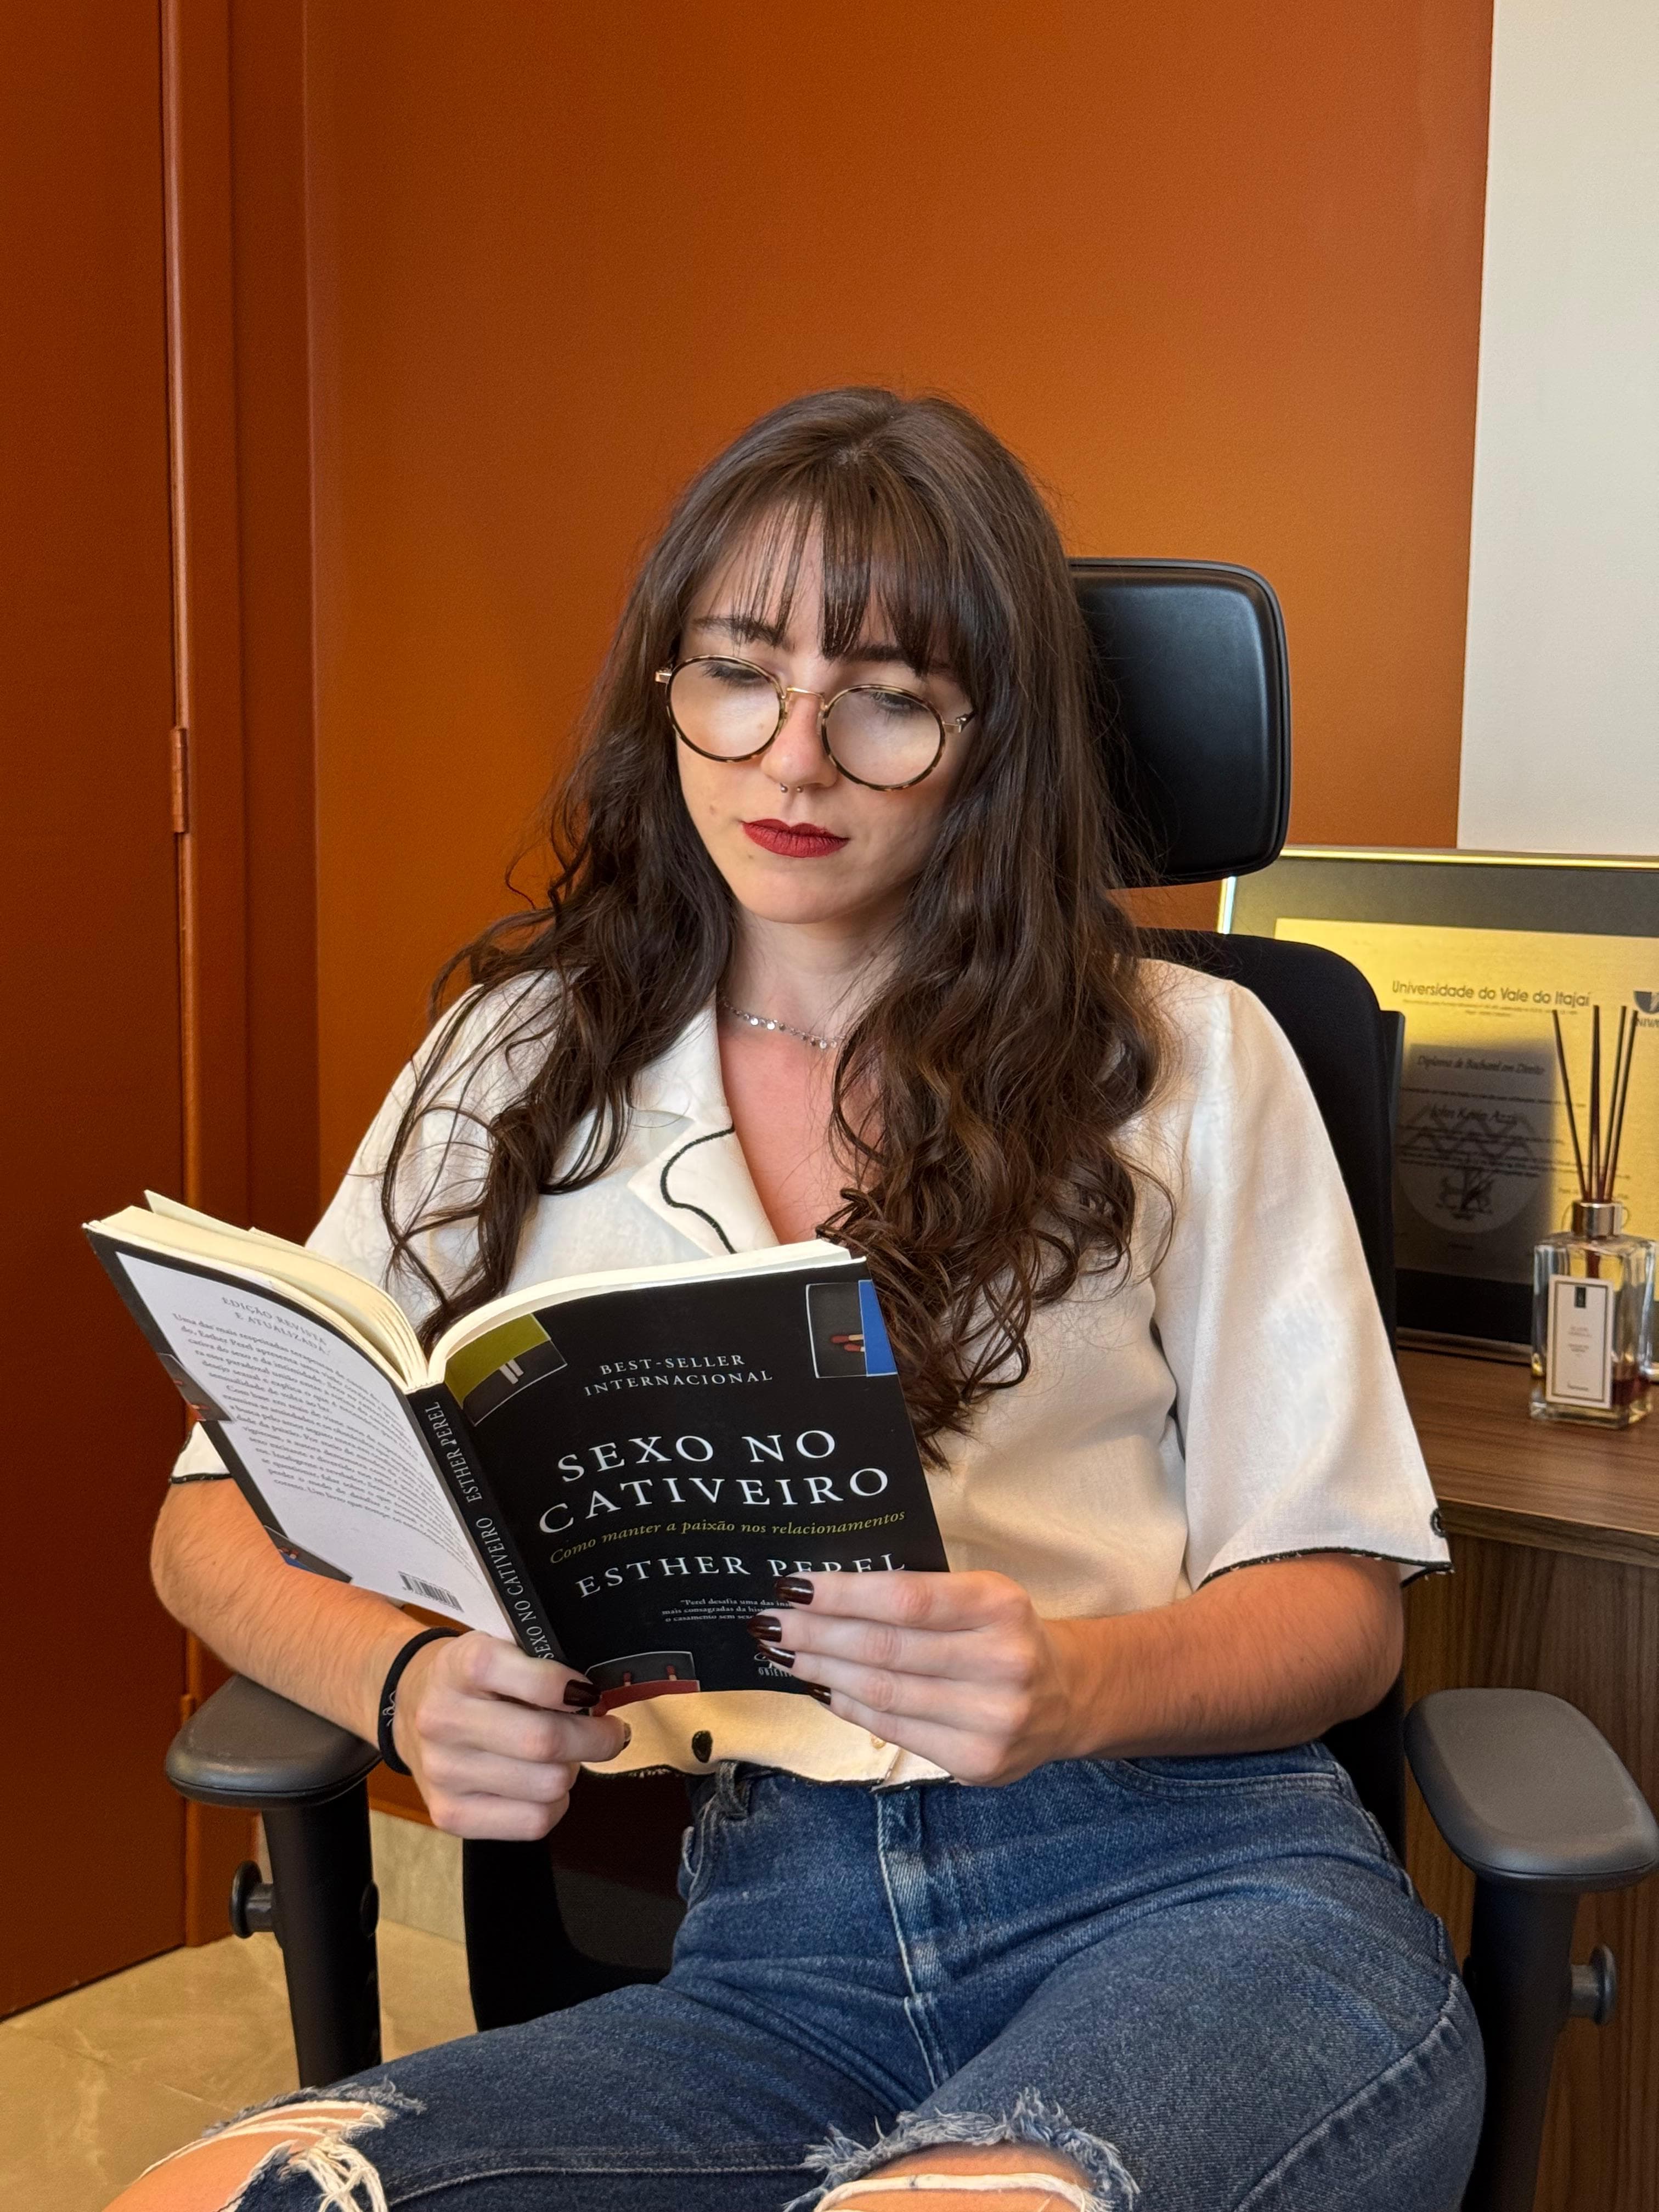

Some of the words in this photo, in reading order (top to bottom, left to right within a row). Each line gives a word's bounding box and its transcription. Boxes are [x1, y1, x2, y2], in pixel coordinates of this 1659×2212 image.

[1392, 980, 1474, 999] Universidade
[1479, 985, 1496, 1000] do
[1501, 988, 1528, 1003] Vale
[1533, 990, 1551, 1005] do
[229, 1339, 253, 1350] Perel
[600, 1355, 745, 1375] BEST-SELLER
[584, 1370, 772, 1396] INTERNACIONAL
[426, 1402, 457, 1446] PEREL
[447, 1448, 482, 1503] ESTHER
[558, 1435, 713, 1482] SEXO
[741, 1430, 835, 1463] NO
[539, 1468, 888, 1533] CATIVEIRO
[476, 1517, 523, 1595] CATIVEIRO
[551, 1539, 596, 1563] Como
[603, 1525, 661, 1542] manter
[667, 1523, 676, 1531] a
[681, 1519, 735, 1534] paixão
[741, 1524, 766, 1533] nos
[772, 1511, 905, 1534] relacionamentos
[575, 1556, 751, 1597] ESTHER
[515, 1600, 536, 1622] NO
